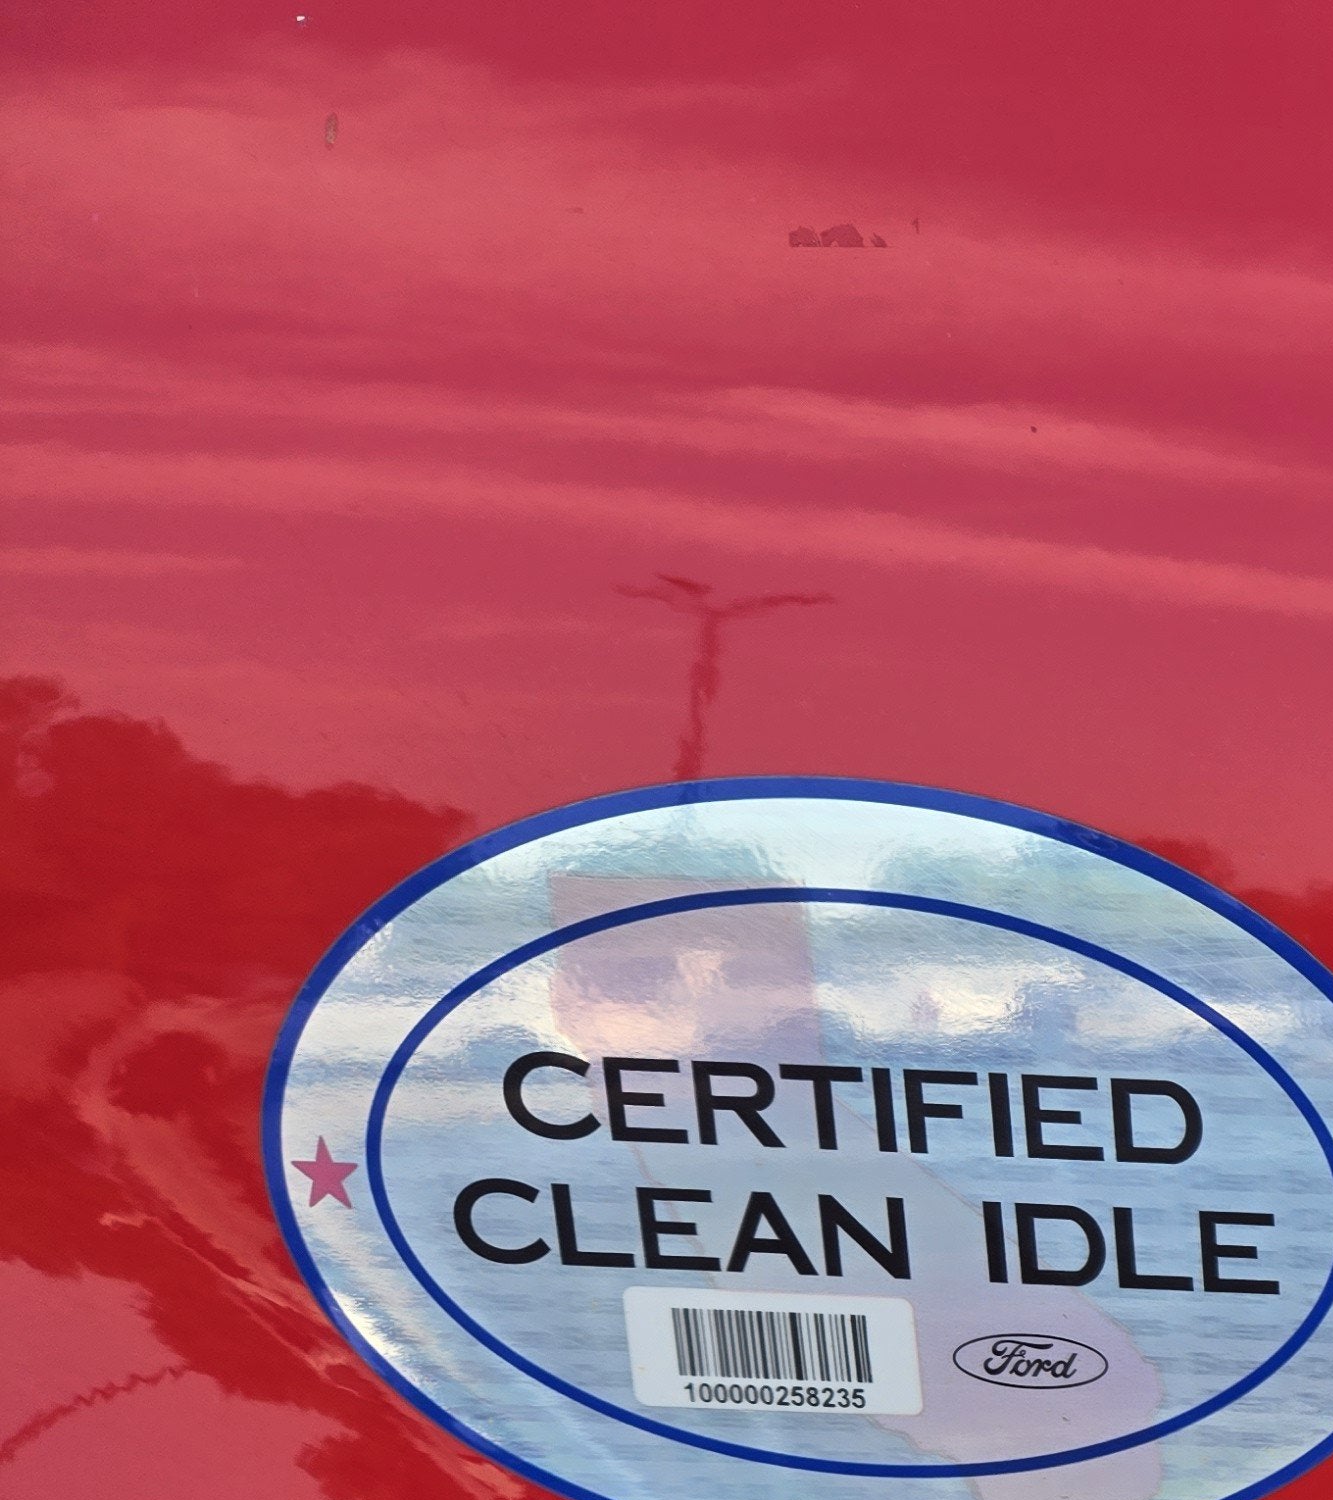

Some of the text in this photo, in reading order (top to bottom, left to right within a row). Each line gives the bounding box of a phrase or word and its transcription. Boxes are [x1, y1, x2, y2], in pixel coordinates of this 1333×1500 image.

[502, 1050, 1203, 1166] CERTIFIED
[452, 1178, 1281, 1297] CLEAN IDLE
[683, 1382, 867, 1410] 100000258235
[983, 1339, 1078, 1380] Ford
